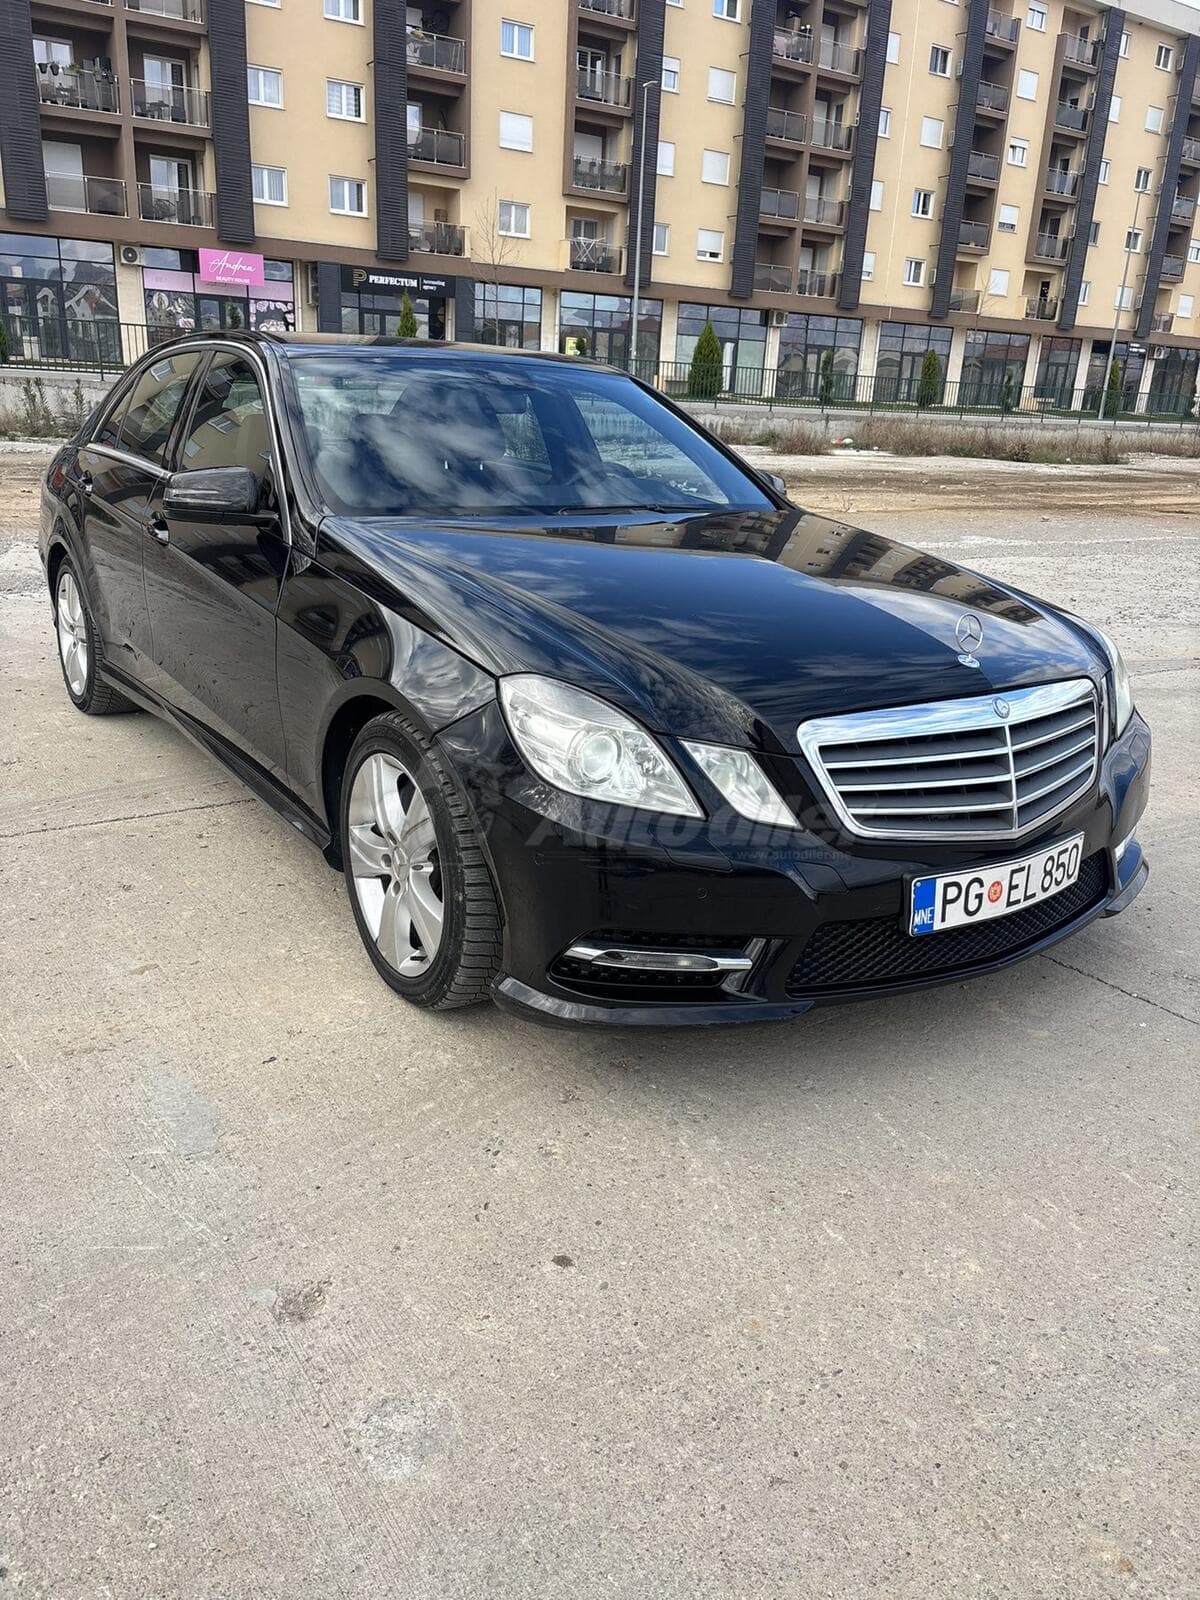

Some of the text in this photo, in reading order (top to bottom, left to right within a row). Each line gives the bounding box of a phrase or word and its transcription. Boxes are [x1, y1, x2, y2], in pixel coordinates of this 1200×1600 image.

[208, 252, 256, 275] Andrea
[369, 274, 418, 287] PERFECTUM
[941, 843, 1080, 922] PG EL 850
[914, 907, 935, 926] MNE
